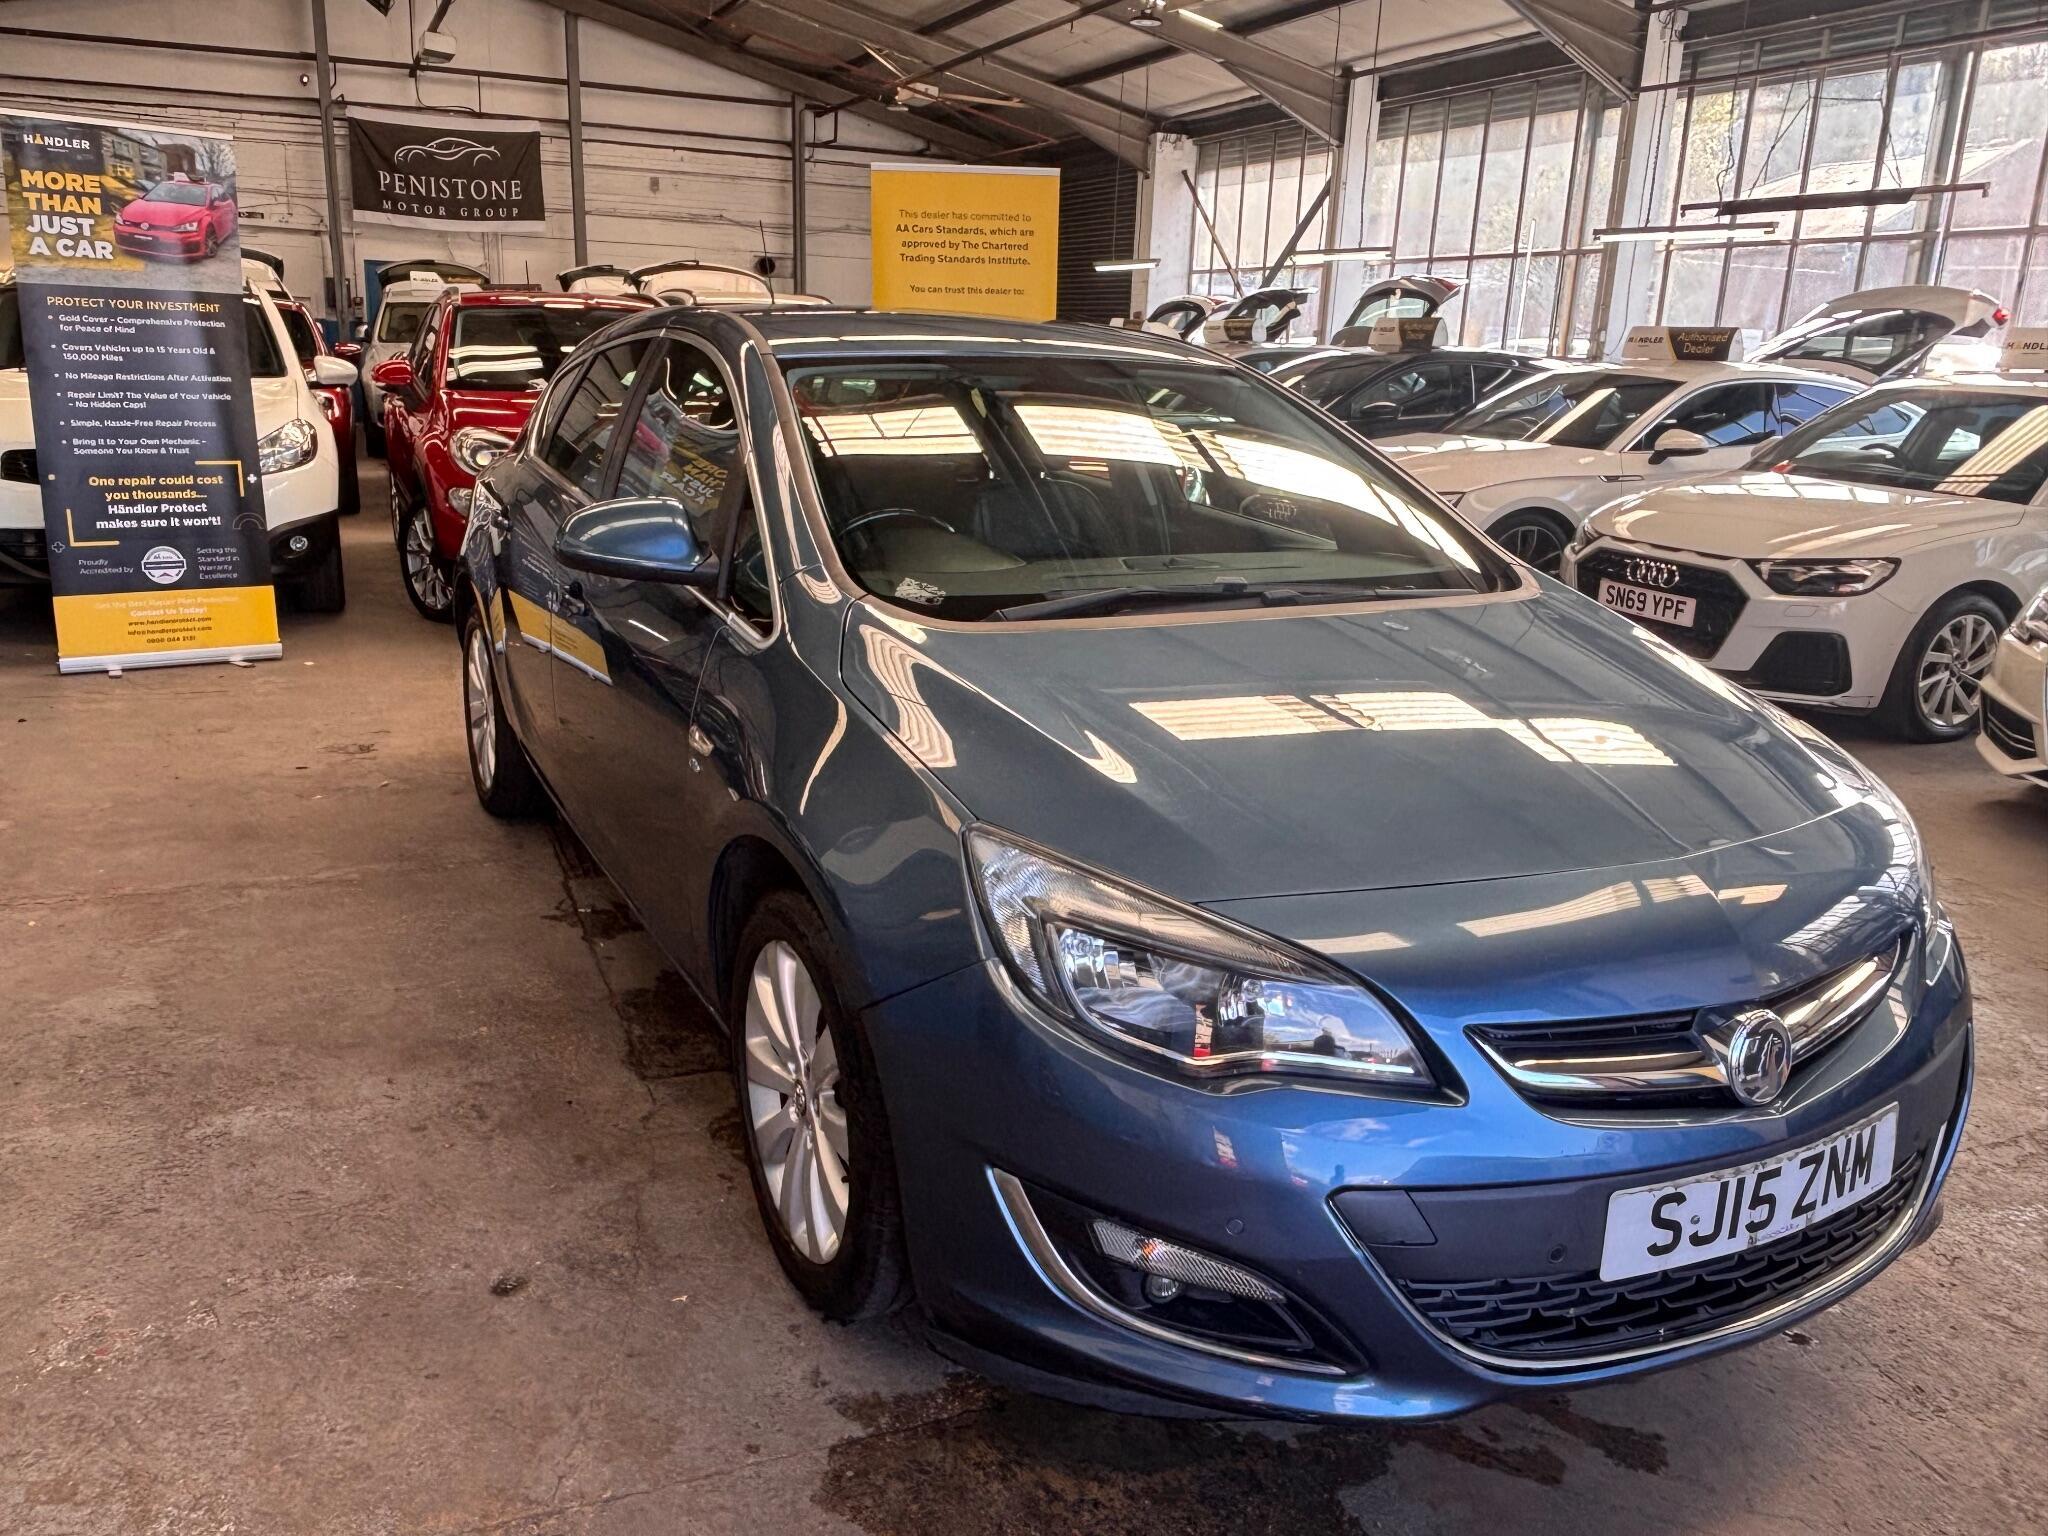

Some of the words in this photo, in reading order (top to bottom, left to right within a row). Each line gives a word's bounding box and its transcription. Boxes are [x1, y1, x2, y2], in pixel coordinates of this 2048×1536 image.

[20, 169, 102, 193] MORE
[378, 170, 522, 200] PENISTONE
[22, 192, 102, 215] THAN
[382, 200, 446, 216] MOTOR
[460, 207, 519, 217] GROUP
[899, 209, 918, 219] This
[921, 210, 950, 220] dealer
[952, 211, 968, 220] has
[970, 211, 1020, 222] committed
[1022, 213, 1031, 222] to
[26, 215, 95, 237] JUST
[896, 224, 910, 233] AA
[912, 225, 933, 233] Cars
[936, 226, 987, 236] Standards,
[989, 227, 1017, 236] which
[28, 236, 51, 256] A
[56, 238, 114, 260] CAR
[901, 240, 946, 249] approved
[948, 240, 959, 251] by
[962, 241, 979, 250] The
[982, 241, 1028, 251] Chartered
[900, 253, 935, 264] Trading
[937, 255, 985, 264] Standards
[988, 255, 1031, 266] Institute.
[909, 284, 926, 293] You
[945, 286, 965, 294] trust
[967, 286, 983, 295] this
[984, 286, 1012, 295] dealer
[1013, 287, 1025, 295] to:
[47, 296, 104, 308] PROTECT
[109, 299, 144, 309] YOUR
[147, 300, 220, 312] INVESTMENT
[82, 315, 108, 323] Cover
[117, 316, 182, 325] Comprehensive
[184, 318, 226, 328] Protection
[75, 324, 101, 333] Peace
[103, 325, 113, 333] of
[115, 325, 136, 334] Mind
[1678, 330, 1730, 342] Authorised
[62, 343, 93, 351] Covers
[95, 344, 131, 352] Vehicles
[132, 346, 144, 354] up
[145, 345, 155, 353] to
[167, 346, 191, 354] Years
[192, 347, 208, 355] Old
[209, 347, 216, 355] &
[1684, 342, 1714, 354] Dealer
[63, 353, 99, 362] 150,000
[101, 353, 123, 362] Miles
[65, 372, 79, 380] No
[80, 372, 114, 381] Mileage
[116, 373, 165, 381] Restrictions
[167, 373, 189, 381] After
[190, 374, 232, 383] Activation
[67, 391, 96, 399] Repair
[97, 391, 124, 399] Limit?
[126, 391, 142, 399] The
[143, 392, 168, 400] Value
[169, 392, 179, 400] of
[201, 393, 232, 401] Vehicle
[75, 400, 89, 408] No
[90, 400, 121, 408] Hidden
[122, 401, 147, 409] Caps!
[70, 419, 103, 427] Simple,
[104, 419, 154, 427] Hassle-Free
[155, 419, 182, 428] Repair
[72, 438, 97, 446] Bring
[88, 476, 115, 486] One
[118, 475, 156, 487] repair
[158, 475, 194, 485] could
[197, 475, 224, 485] cost
[105, 492, 130, 502] you
[161, 502, 208, 513] Protect
[95, 518, 138, 529] makes
[140, 519, 168, 528] sure
[78, 558, 109, 566] Proudly
[79, 567, 123, 575] Accredited
[123, 566, 134, 574] by
[1605, 584, 1647, 612] SN69
[1652, 594, 1687, 620] YPF
[130, 609, 164, 617] Contact
[1647, 1166, 1782, 1257] SJ15
[1791, 1124, 1877, 1220] ZNM
